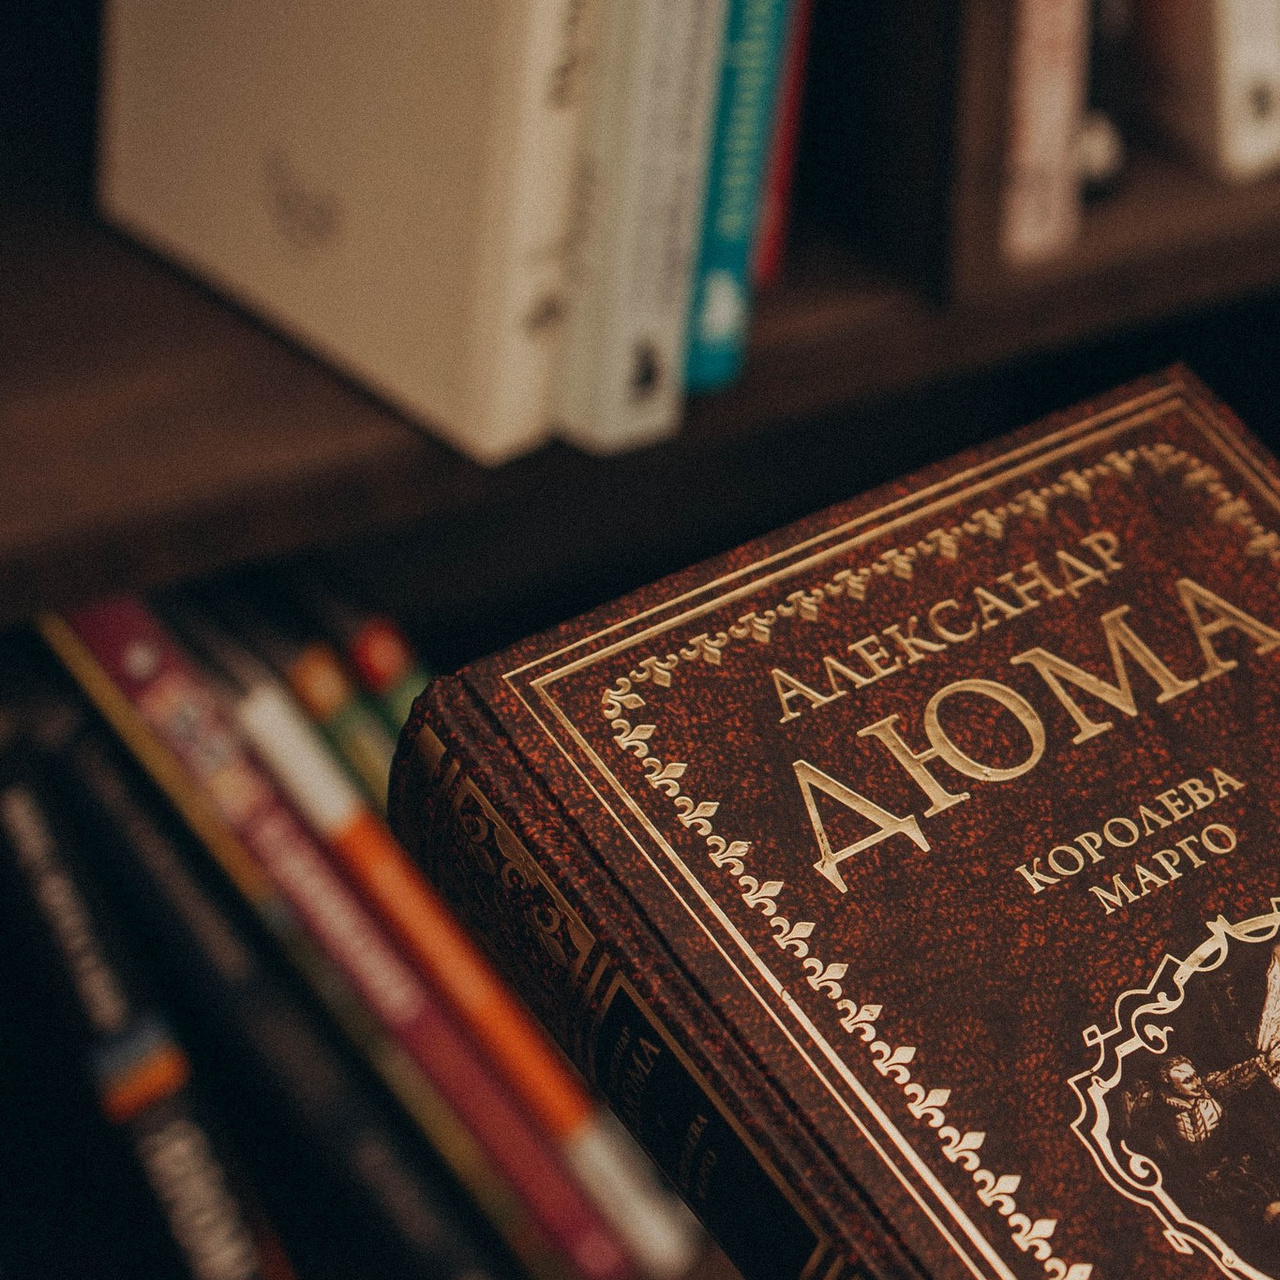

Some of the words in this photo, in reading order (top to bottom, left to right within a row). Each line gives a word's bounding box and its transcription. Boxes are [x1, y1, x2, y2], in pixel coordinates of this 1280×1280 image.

[770, 531, 1124, 724] АЛЕКСАНДР
[1014, 767, 1245, 894] КОРОЛЕВА
[1088, 822, 1238, 916] МАРГО
